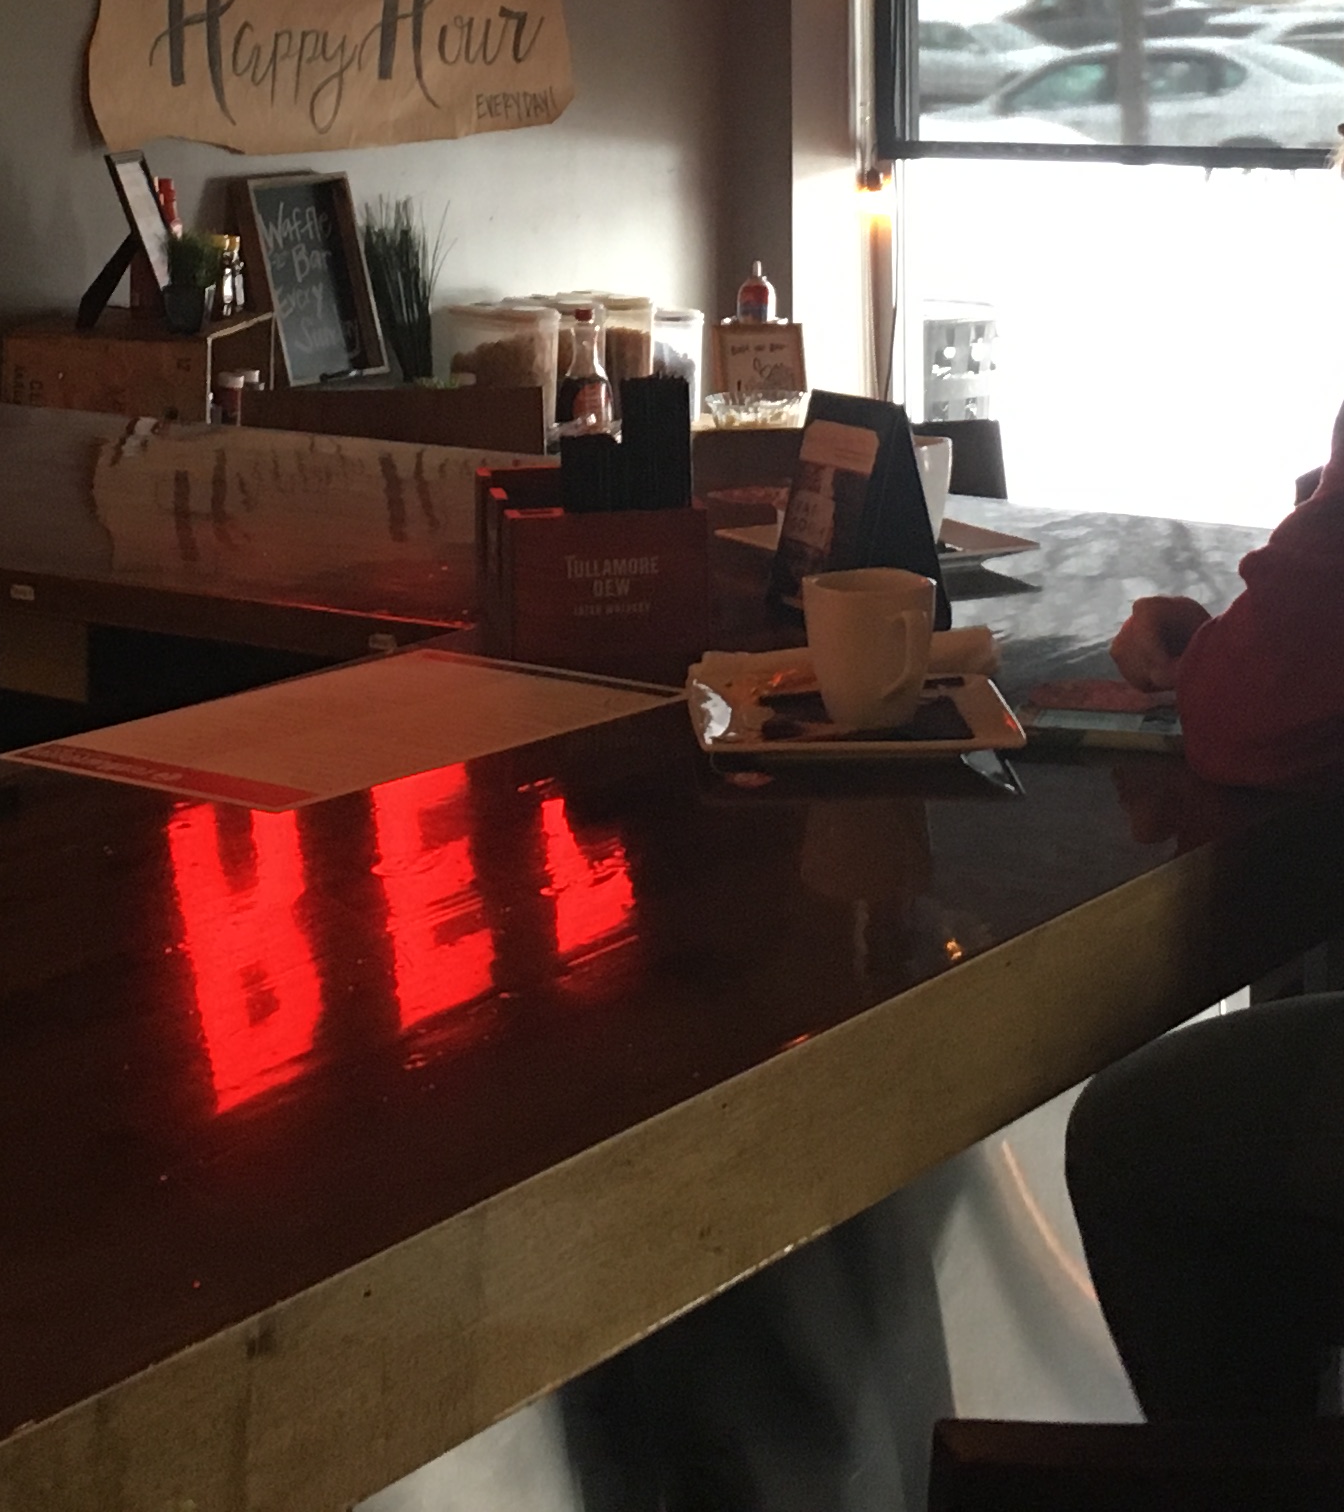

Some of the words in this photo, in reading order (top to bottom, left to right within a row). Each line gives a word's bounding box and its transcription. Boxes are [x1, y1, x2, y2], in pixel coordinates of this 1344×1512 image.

[258, 201, 333, 254] Waffle
[291, 242, 333, 284] Bar
[564, 554, 660, 580] TULLAMORE
